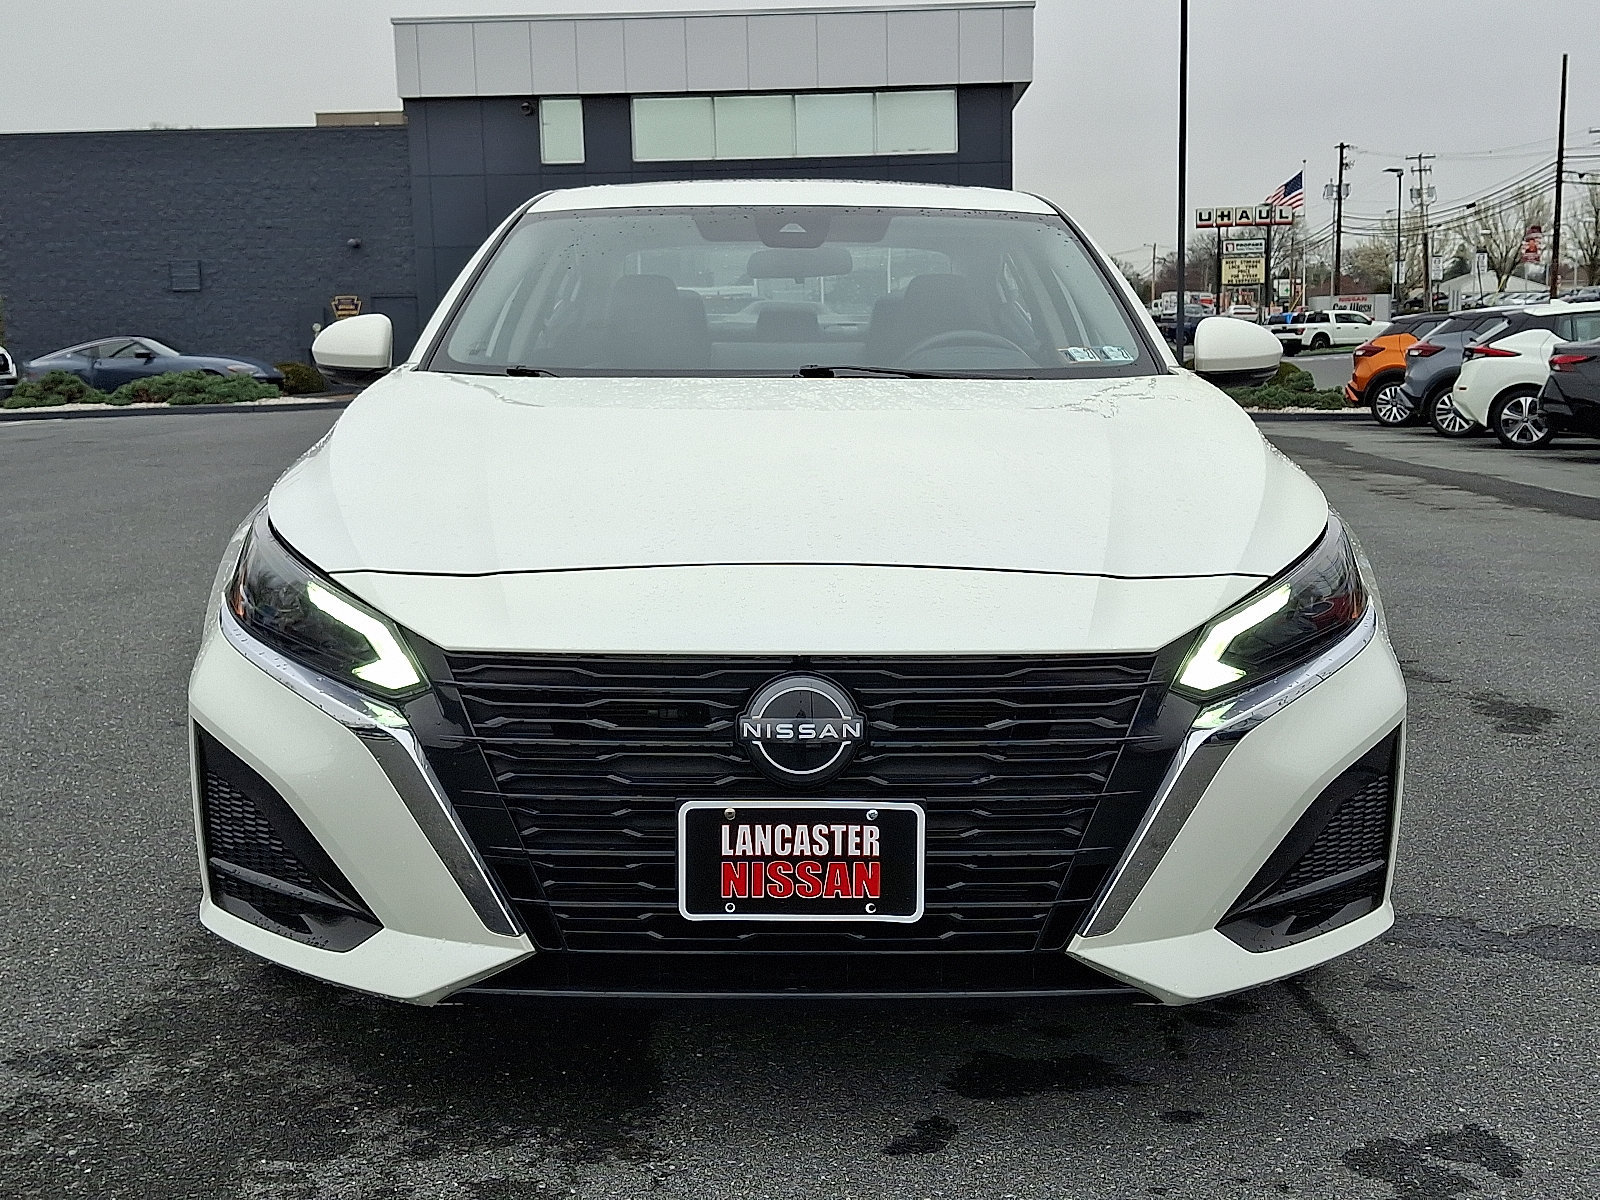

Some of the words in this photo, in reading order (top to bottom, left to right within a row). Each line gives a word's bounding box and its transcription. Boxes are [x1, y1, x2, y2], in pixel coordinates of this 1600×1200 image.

[743, 722, 861, 739] NISSAN
[721, 824, 880, 856] LANCASTER
[720, 860, 881, 899] NISSAN
